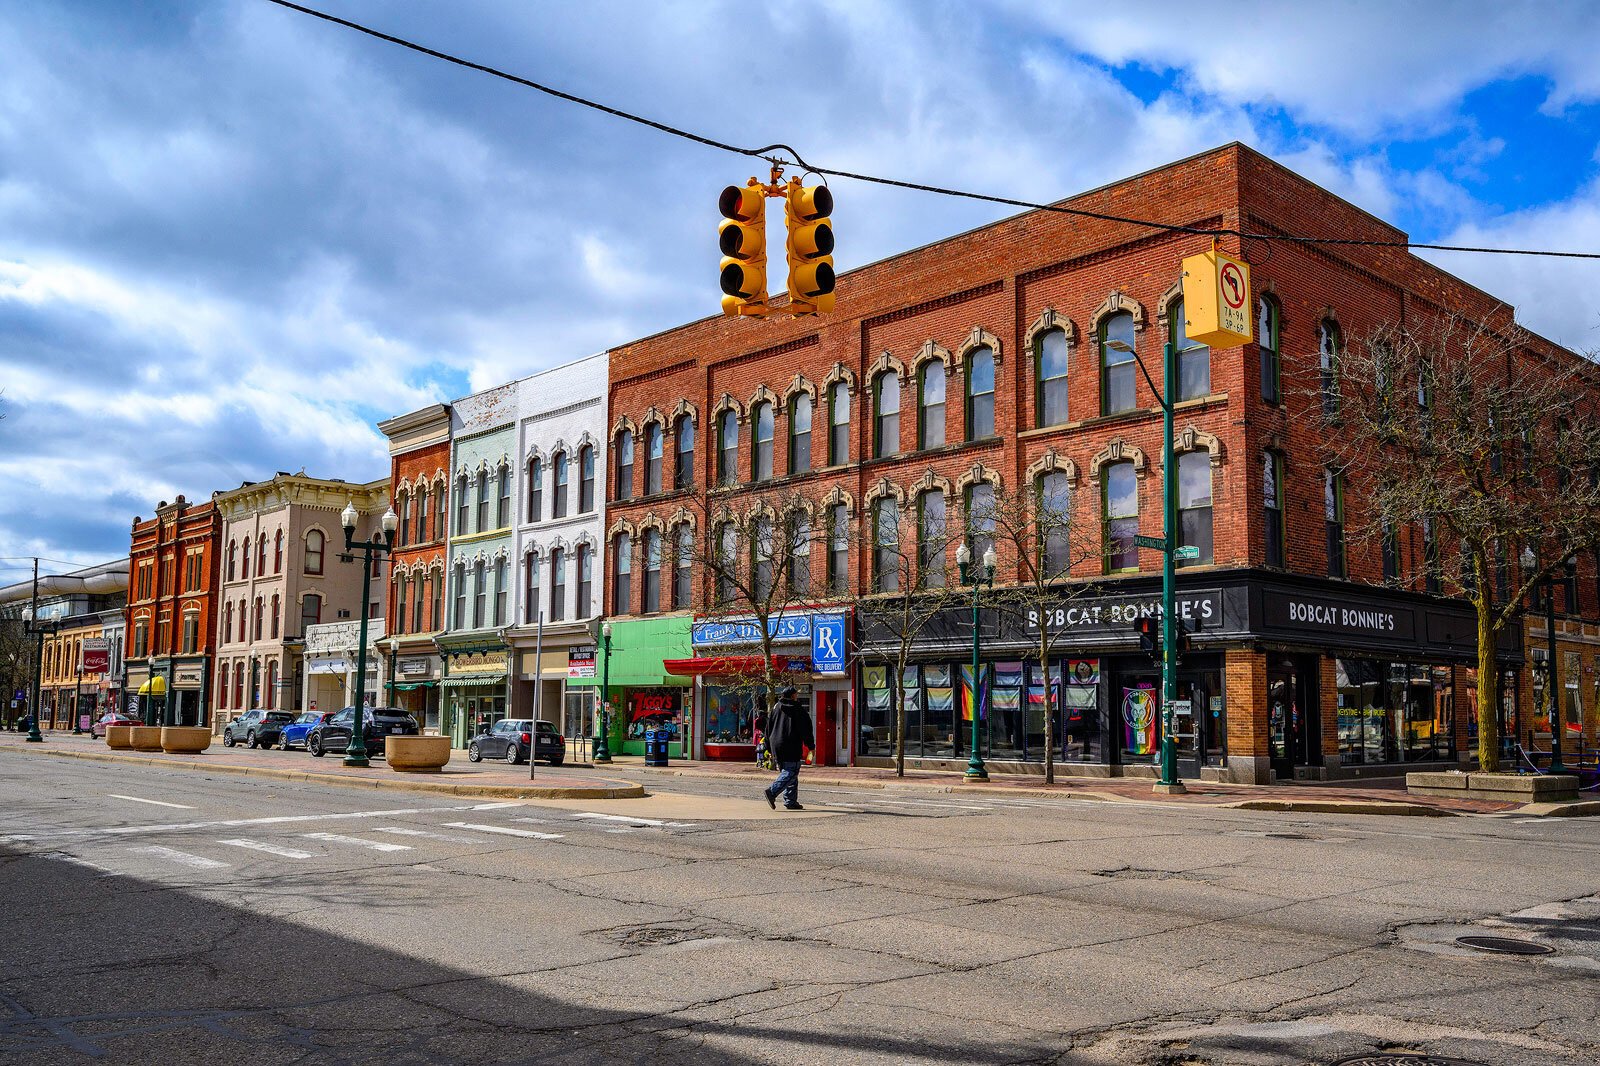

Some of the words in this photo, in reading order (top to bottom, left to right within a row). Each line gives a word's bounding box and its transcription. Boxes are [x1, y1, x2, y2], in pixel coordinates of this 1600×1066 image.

[1134, 536, 1166, 549] WASHINGTON
[1028, 606, 1102, 628] BOBCAT
[1289, 602, 1337, 625] BOBCAT
[1342, 608, 1394, 631] BONNIE'S
[741, 620, 795, 637] DRUGS
